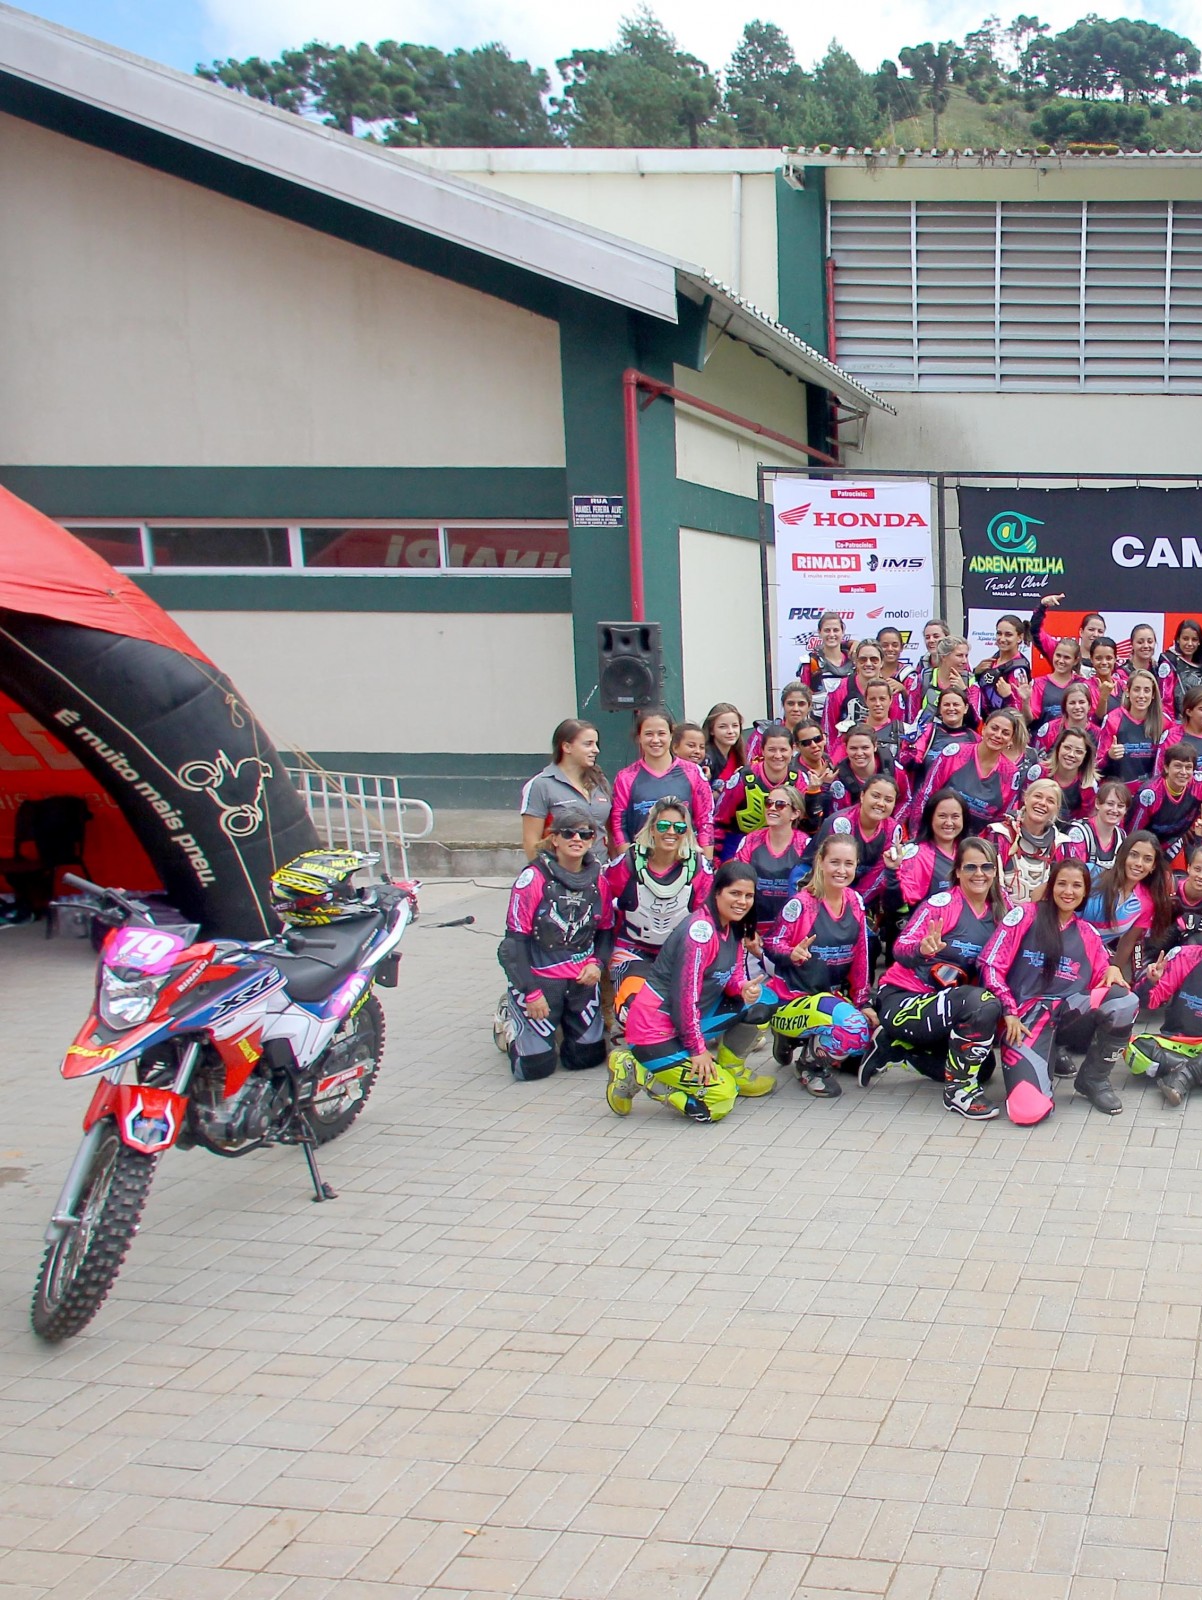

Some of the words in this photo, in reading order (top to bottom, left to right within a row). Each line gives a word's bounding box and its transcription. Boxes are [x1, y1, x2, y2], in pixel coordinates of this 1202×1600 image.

[813, 512, 928, 527] HONDA
[969, 555, 1064, 574] ADRENATRILHA
[985, 577, 1017, 591] Trail
[1021, 574, 1048, 589] Club
[884, 608, 929, 619] motofield
[54, 709, 80, 727] É
[75, 727, 140, 782] muito
[135, 782, 184, 831] mais
[171, 833, 216, 888] pneu.
[177, 960, 209, 993] RINALDI
